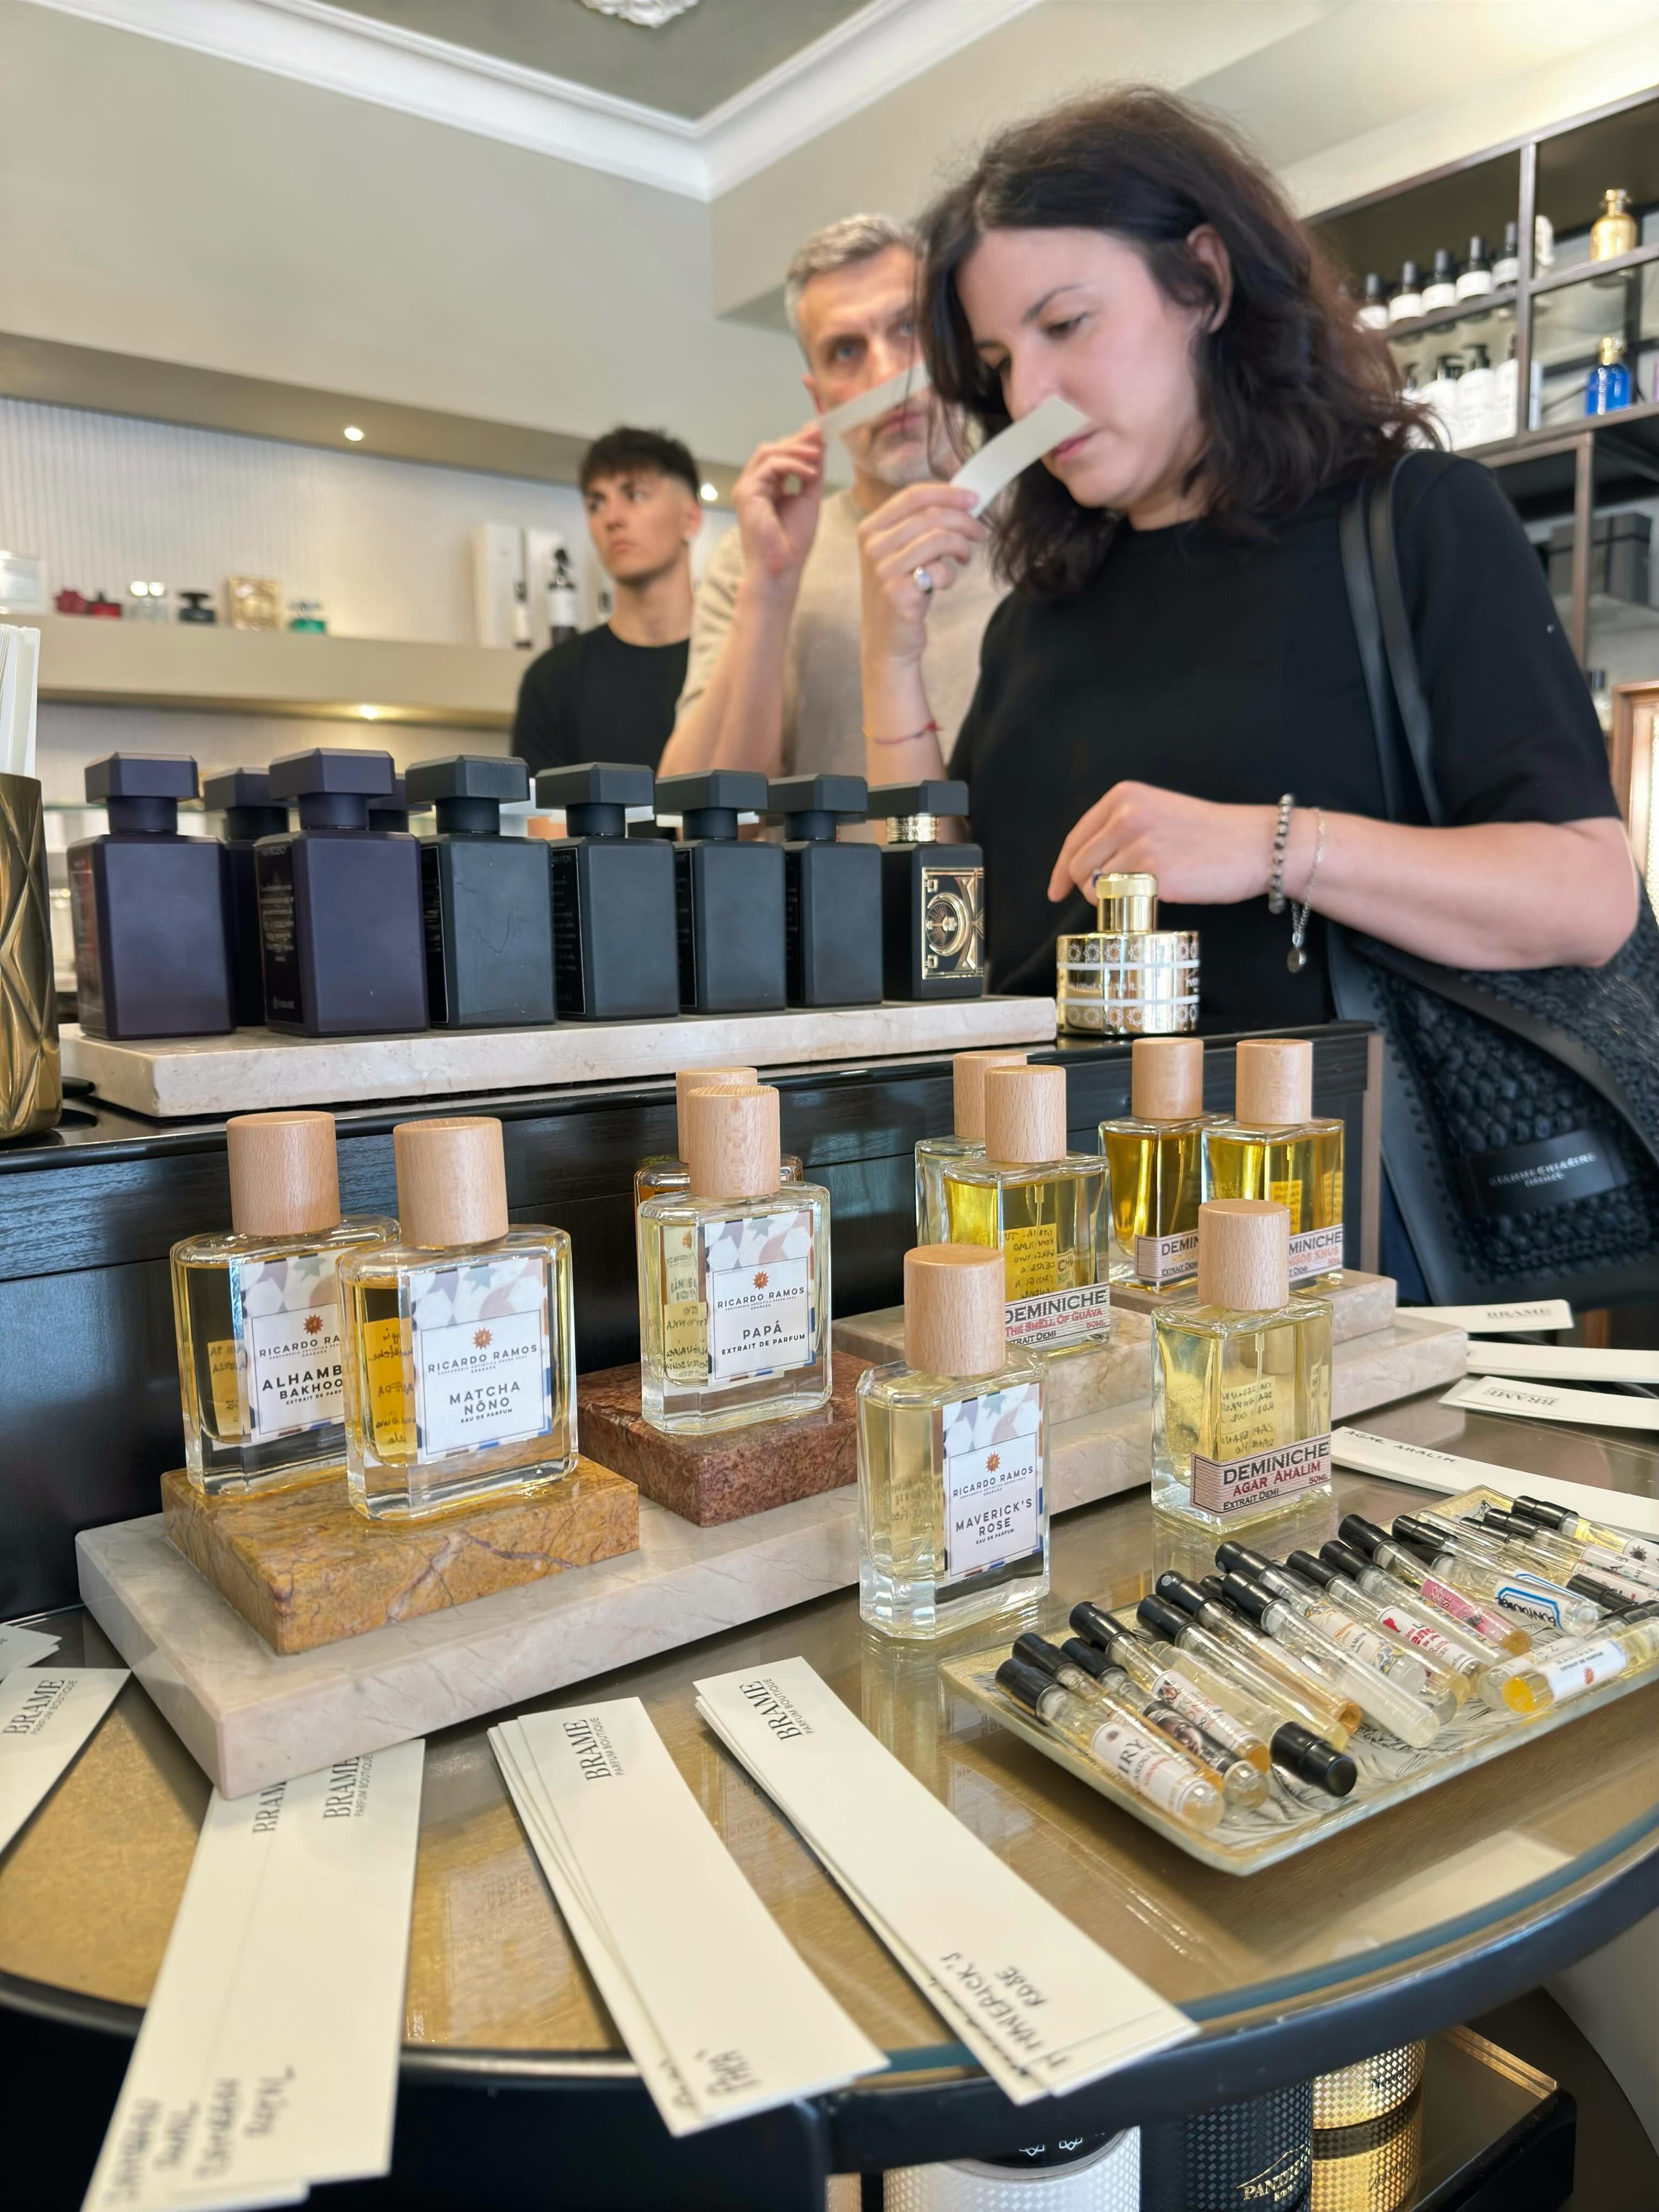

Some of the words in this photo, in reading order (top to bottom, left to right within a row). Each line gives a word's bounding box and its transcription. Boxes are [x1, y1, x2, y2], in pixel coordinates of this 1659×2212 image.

[1162, 1236, 1198, 1256] DEMIN
[1289, 1232, 1341, 1255] MINICHE
[718, 1294, 764, 1308] RICARDO
[768, 1287, 804, 1299] RAMOS
[743, 1320, 782, 1340] PAPÁ
[1036, 1330, 1056, 1341] DEMI
[259, 1339, 318, 1357] RICARDO
[721, 1343, 756, 1355] EXTRAIT
[773, 1334, 805, 1344] PARFUM
[428, 1354, 487, 1373] RICARDO
[494, 1344, 537, 1360] RAMOS
[262, 1365, 342, 1391] ALHAMB
[280, 1379, 342, 1400] BAKHOO
[286, 1396, 313, 1404] EXTRAIT
[449, 1381, 520, 1405] MATCHA
[487, 1408, 512, 1417] PARFUM
[1344, 1430, 1385, 1444] AGAR
[1223, 1442, 1329, 1484] DEMINICHE
[953, 1477, 996, 1498] RICARDO
[1000, 1466, 1033, 1482] RAMOS
[1233, 1477, 1267, 1496] AGAR
[1273, 1461, 1320, 1484] AHALIM
[956, 1498, 1032, 1531] MAVERICK'S
[979, 1517, 1010, 1536] ROSE
[995, 1528, 1014, 1538] PARFUM
[763, 1678, 793, 1709] BOUTIQUE
[2, 1679, 65, 1733] BRAME
[739, 1681, 804, 1740] BRAME
[590, 1717, 612, 1749] BOUTIQUE
[788, 1709, 815, 1734] PARFUM
[563, 1719, 612, 1780] BRAME
[604, 1750, 625, 1776] PARFUM
